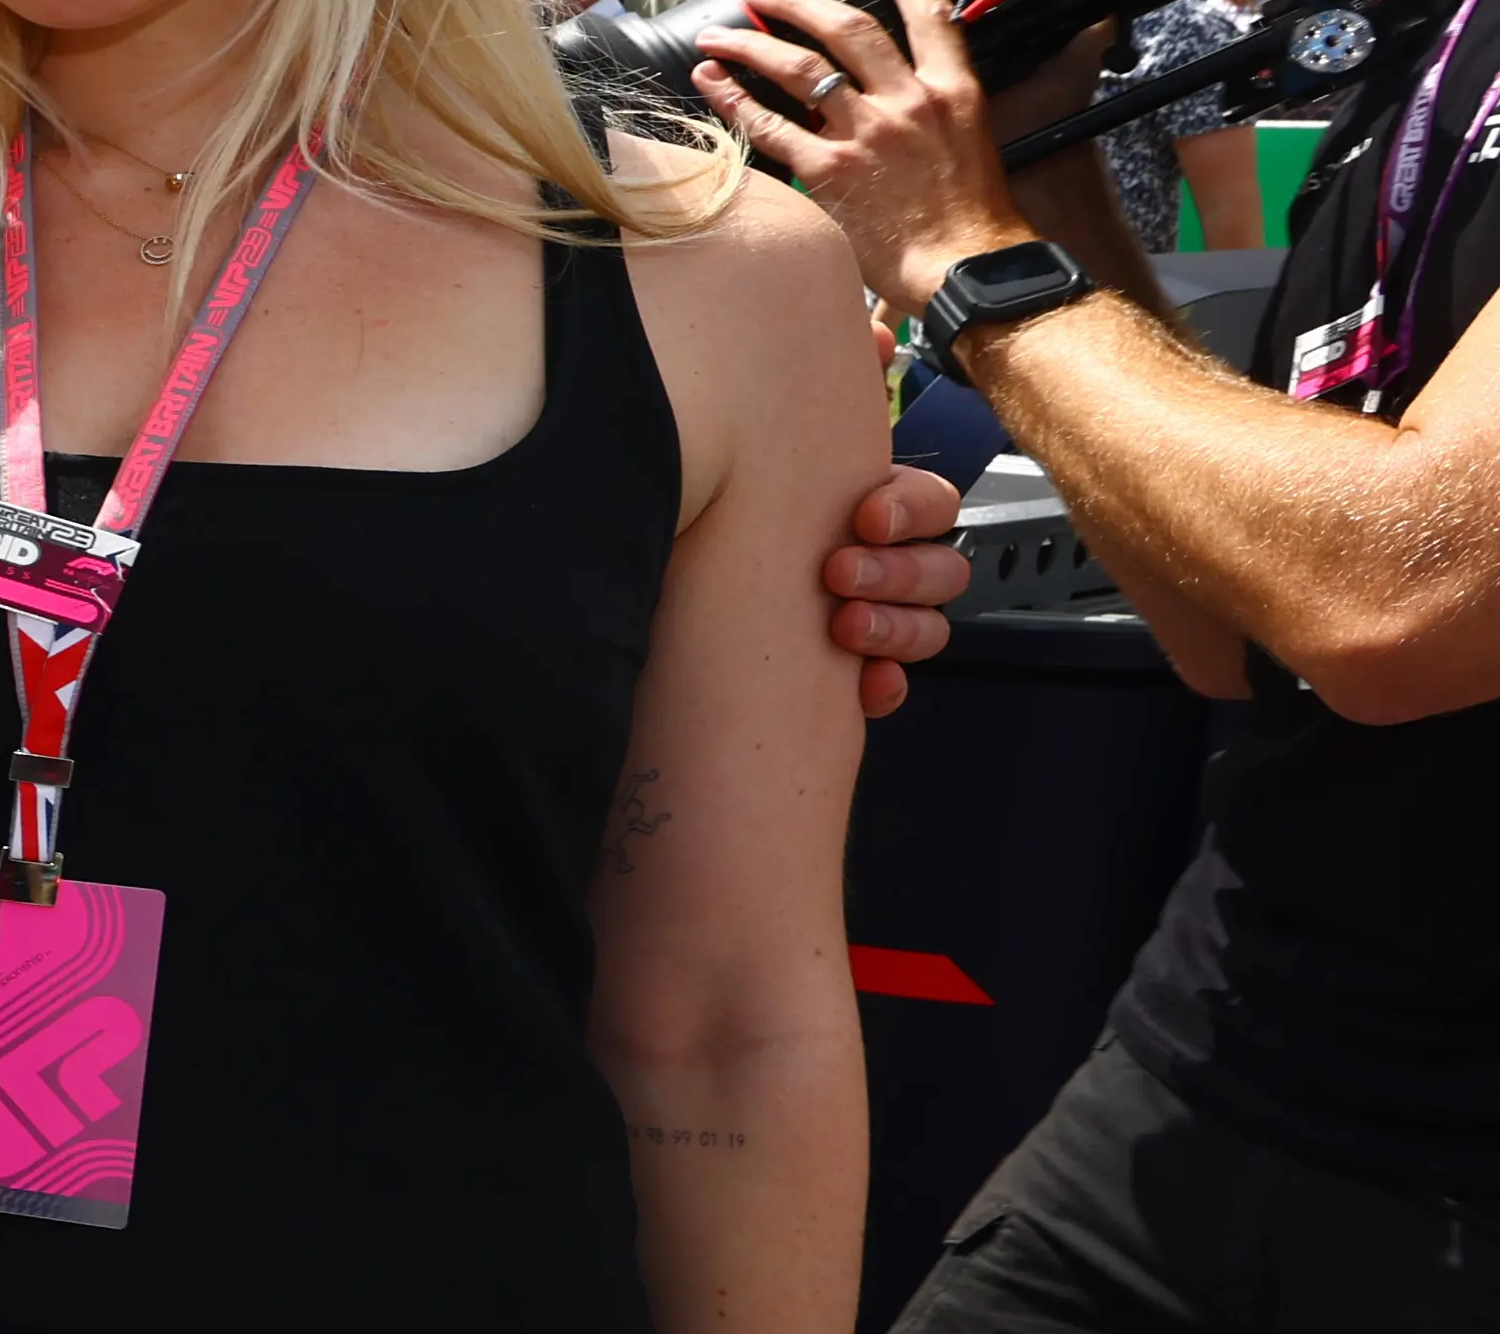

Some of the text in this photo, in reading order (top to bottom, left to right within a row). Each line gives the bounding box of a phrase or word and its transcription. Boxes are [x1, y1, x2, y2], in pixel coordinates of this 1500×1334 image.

[1390, 141, 1422, 213] GREAT
[146, 332, 219, 436] BRITAIN
[49, 524, 97, 550] 23
